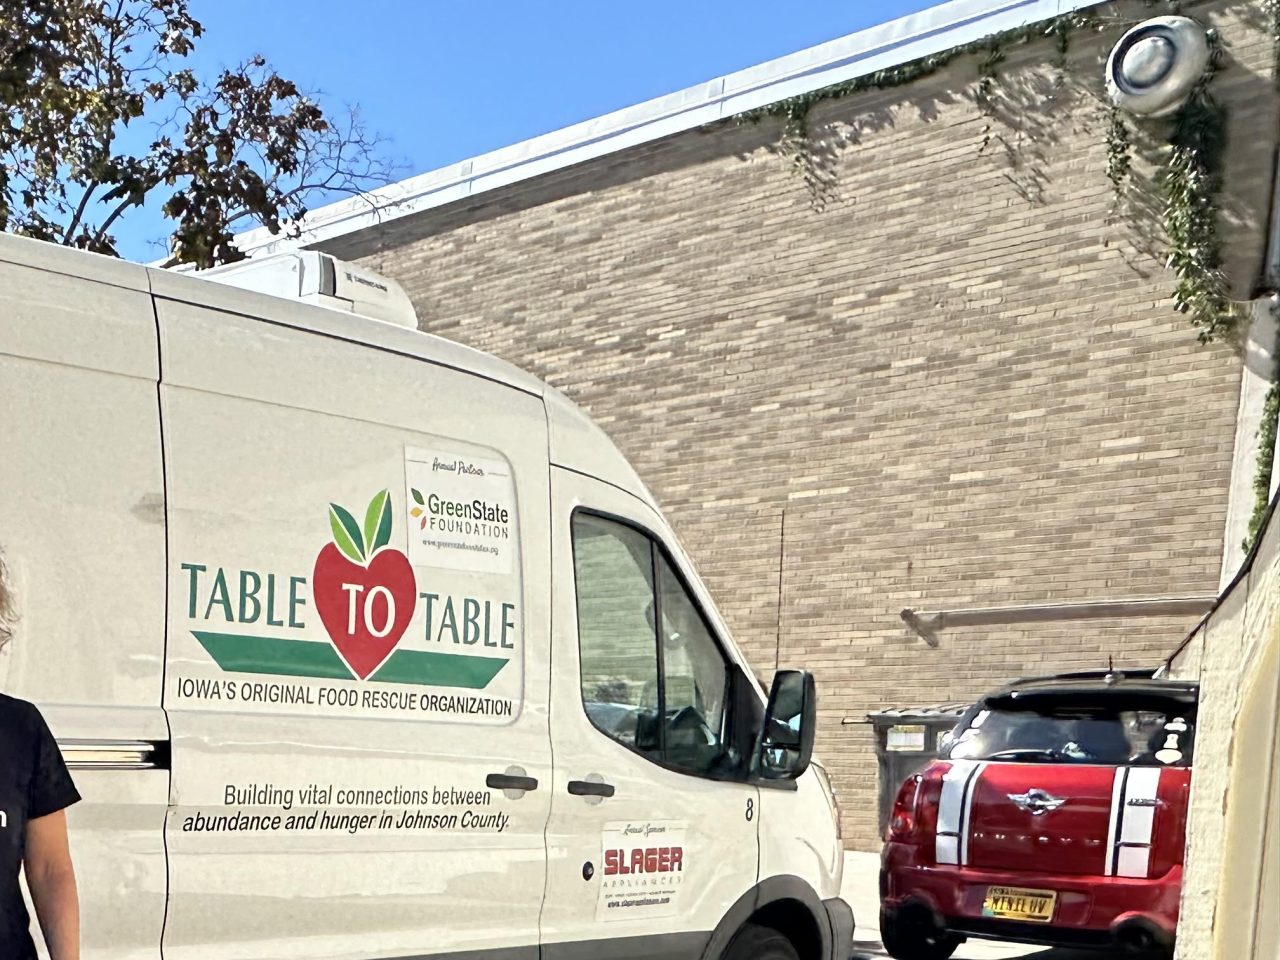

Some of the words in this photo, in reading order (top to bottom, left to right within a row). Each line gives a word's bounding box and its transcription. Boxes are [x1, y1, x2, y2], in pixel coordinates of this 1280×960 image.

[428, 493, 508, 524] GreenState
[429, 517, 508, 539] FOUNDATION
[180, 562, 307, 629] TABLE
[341, 582, 397, 638] TO
[419, 592, 516, 650] TABLE
[177, 676, 237, 701] IOWA'S
[240, 681, 315, 706] ORIGINAL
[318, 687, 359, 707] FOOD
[361, 690, 418, 712] RESCUE
[419, 694, 513, 717] ORGANIZATION
[224, 785, 294, 810] Building
[298, 785, 333, 805] vital
[336, 785, 429, 806] connections
[432, 785, 492, 806] between
[745, 797, 754, 822] 8
[182, 811, 282, 832] abundance
[285, 811, 317, 831] and
[320, 811, 376, 834] hunger
[379, 809, 393, 829] in
[396, 810, 457, 830] Johnson
[460, 810, 510, 832] County.
[604, 846, 683, 876] SLAGER
